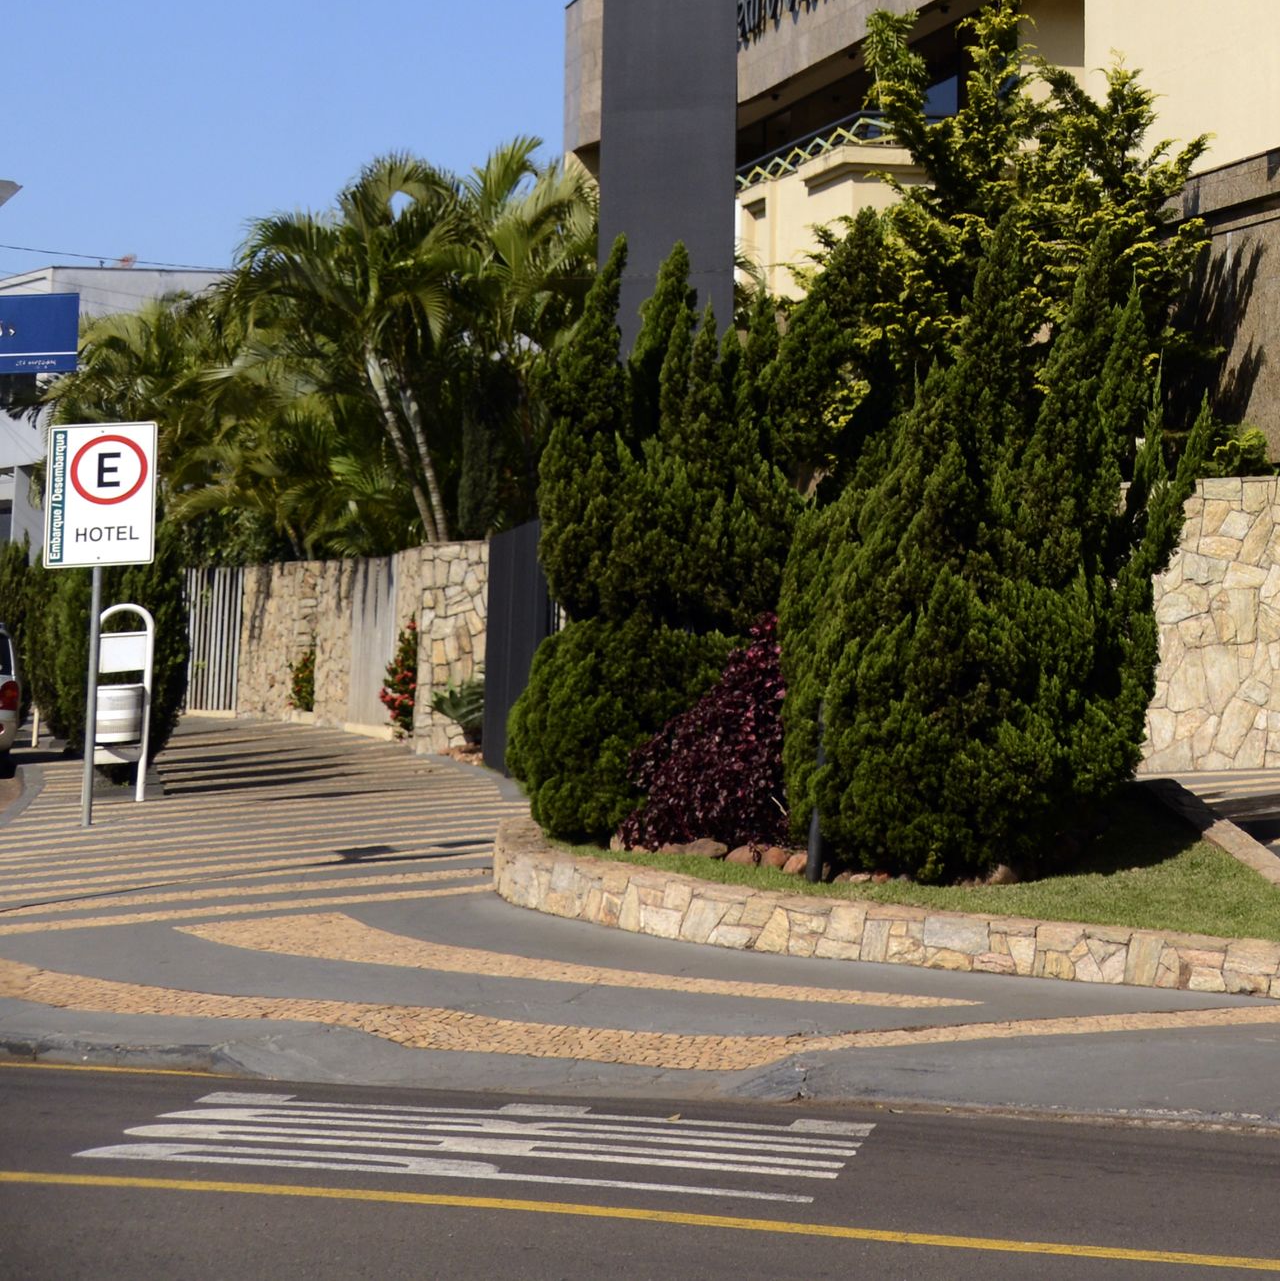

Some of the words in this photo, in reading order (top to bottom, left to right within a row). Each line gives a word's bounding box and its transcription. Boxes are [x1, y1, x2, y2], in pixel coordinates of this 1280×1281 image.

[52, 433, 67, 501] Desembarque
[97, 452, 121, 488] E
[50, 508, 64, 560] Embarque
[75, 526, 140, 543] HOTEL
